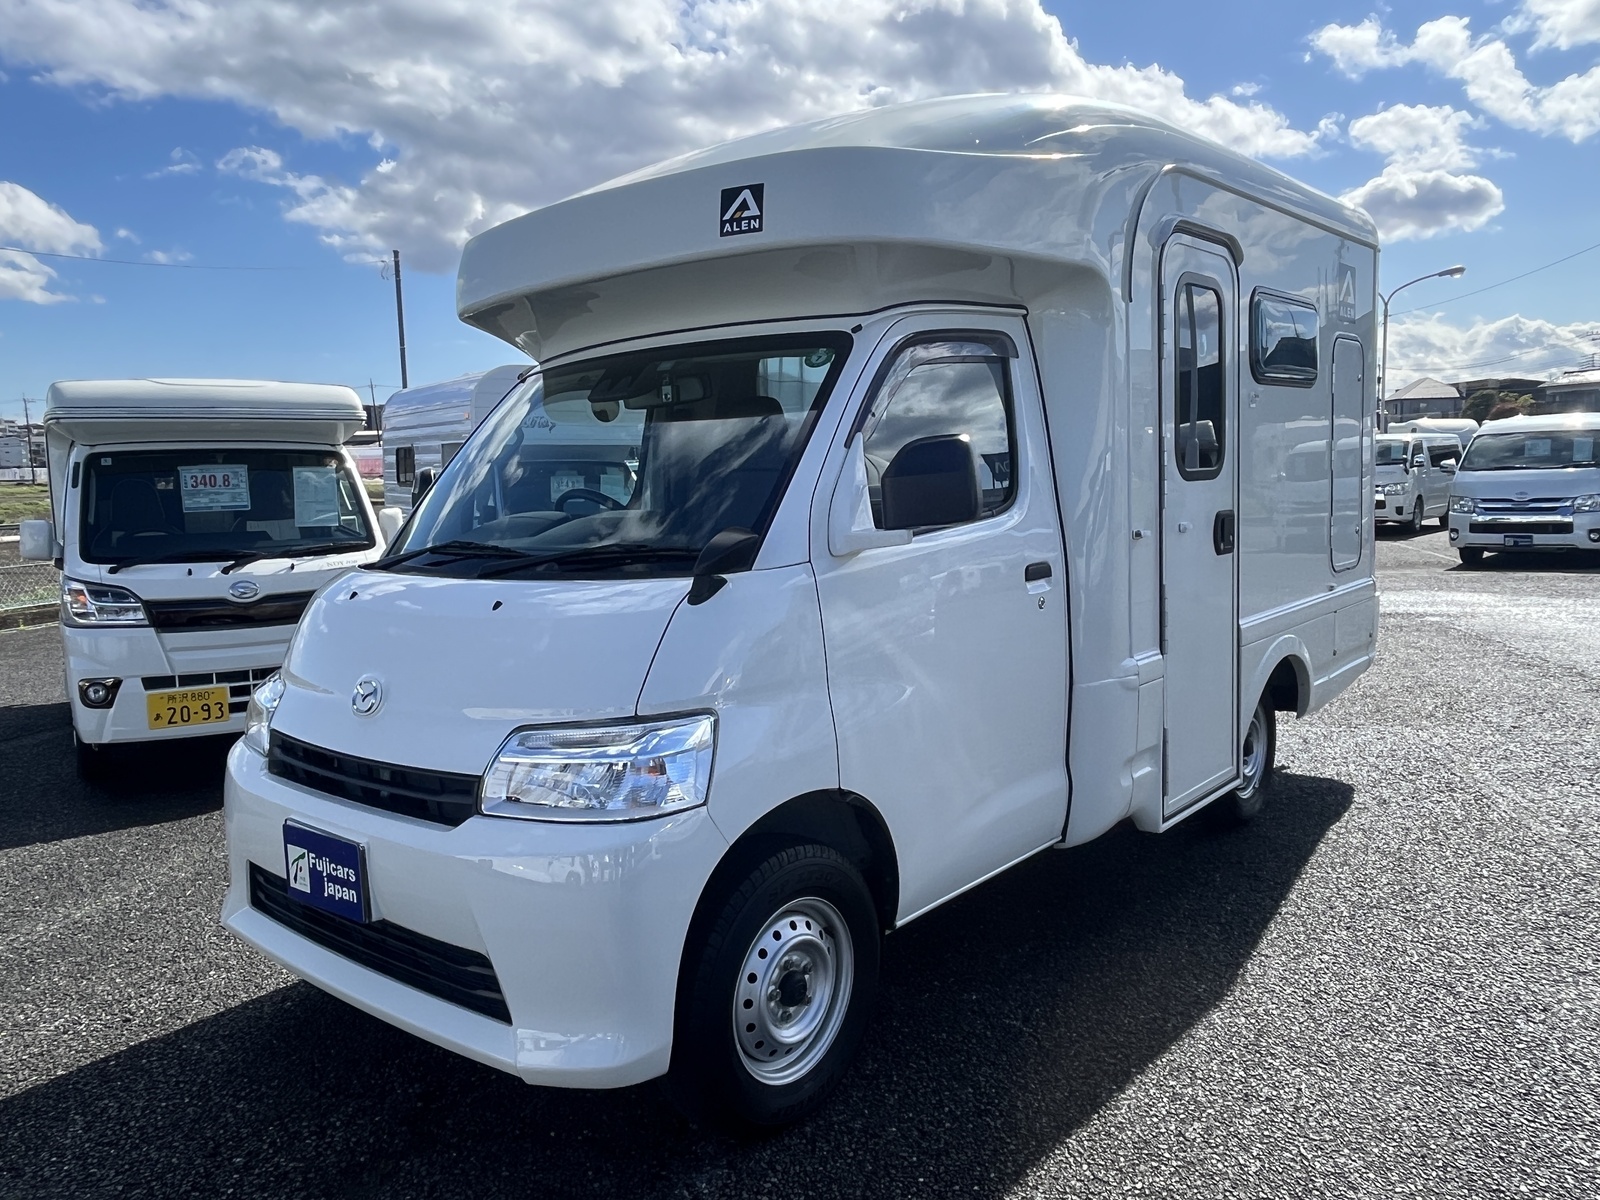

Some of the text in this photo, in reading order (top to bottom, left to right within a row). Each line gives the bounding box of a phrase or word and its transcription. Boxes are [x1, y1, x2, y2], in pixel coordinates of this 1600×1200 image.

[723, 219, 759, 233] ALEN
[1340, 306, 1355, 318] ALEN
[190, 474, 231, 489] 340.8
[167, 702, 224, 725] 20-93
[309, 852, 356, 882] Fujicars
[324, 877, 357, 903] japan
